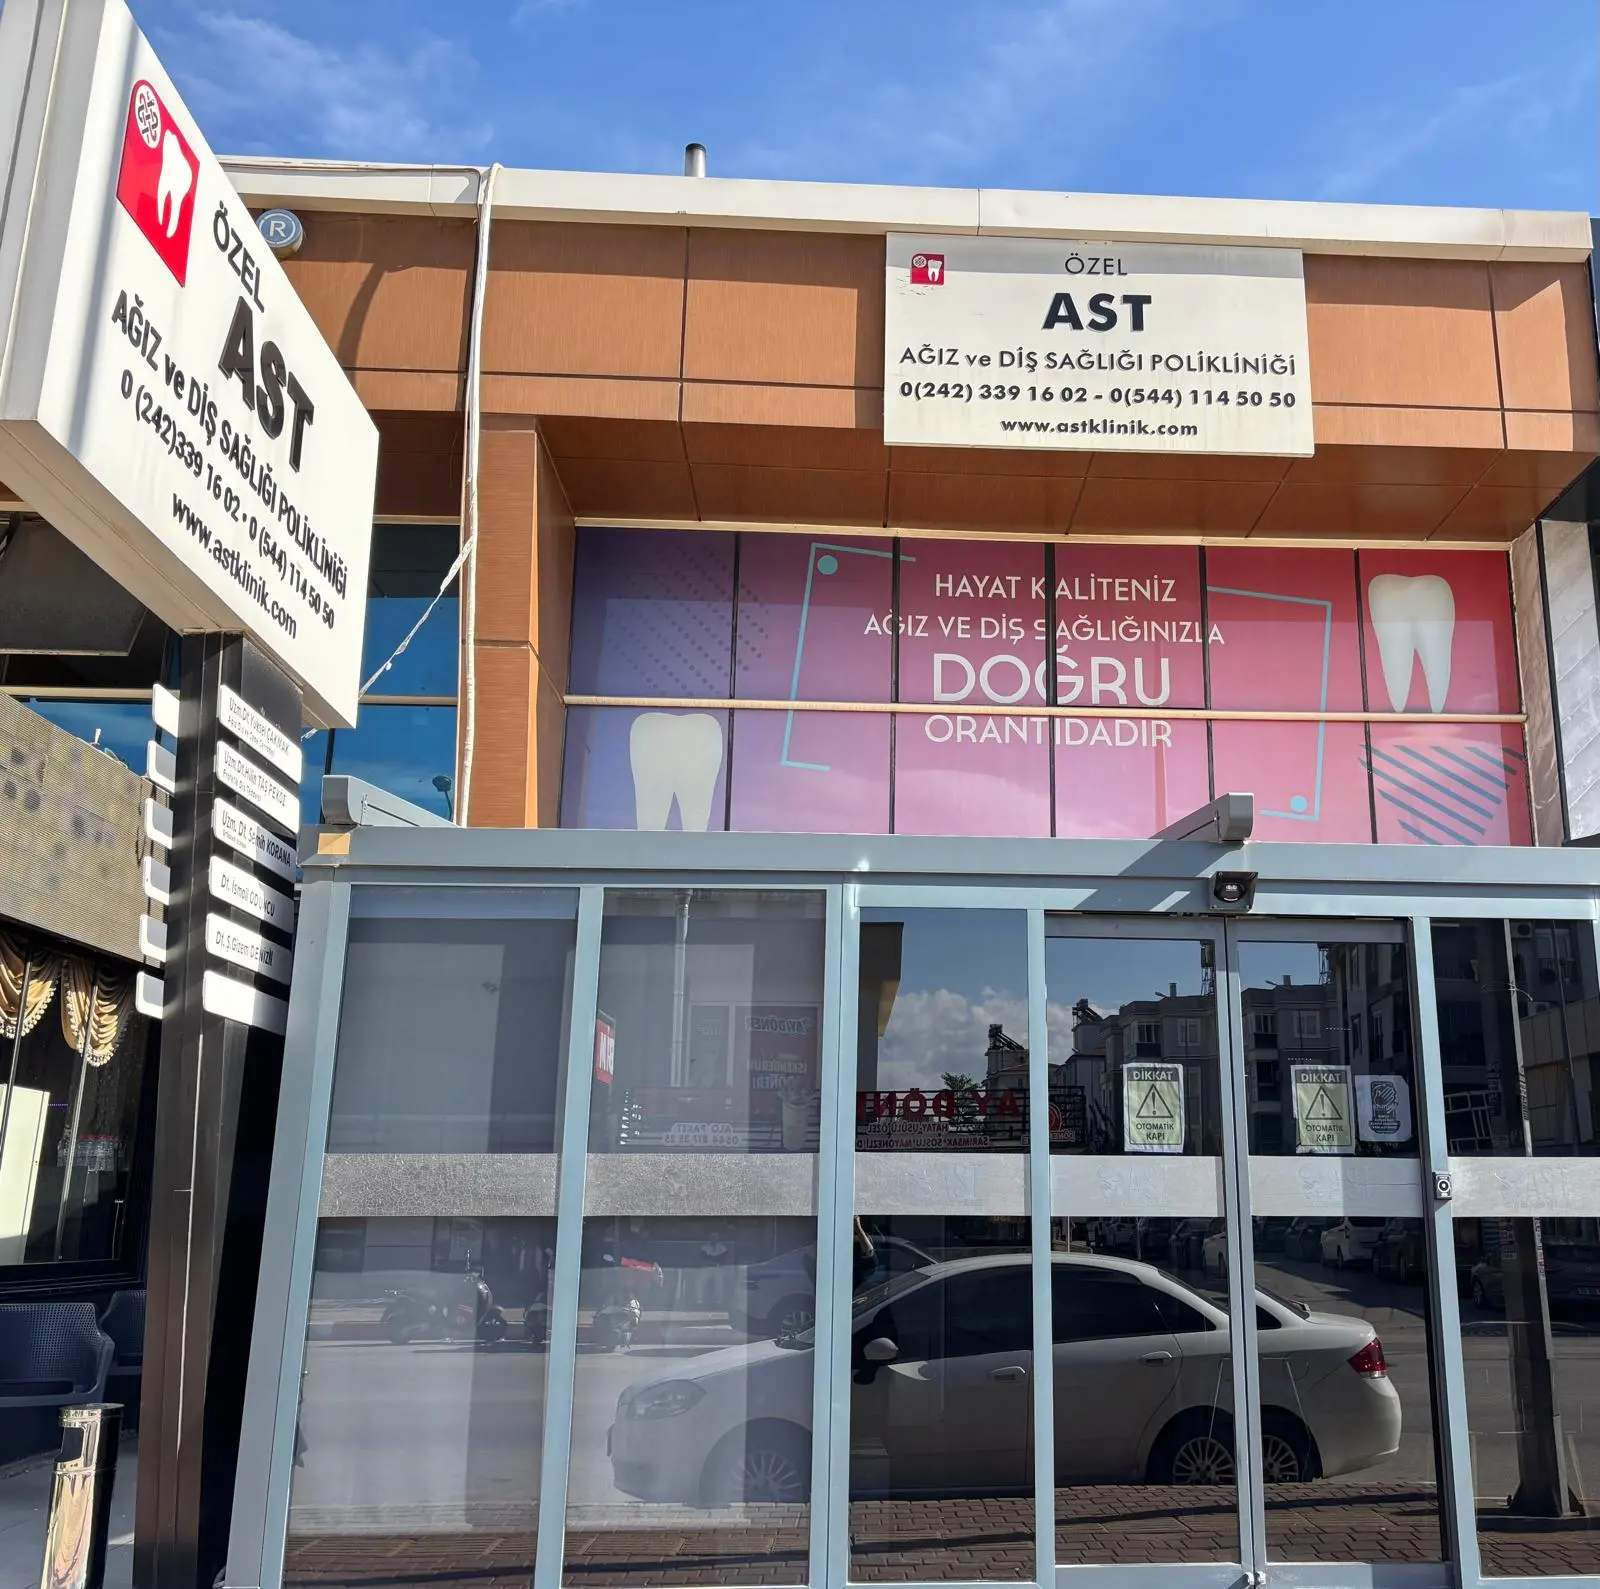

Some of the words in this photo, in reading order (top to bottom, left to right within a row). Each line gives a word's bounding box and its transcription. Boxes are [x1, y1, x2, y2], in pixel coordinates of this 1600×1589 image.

[269, 220, 286, 238] R
[213, 200, 264, 313] ÖZEL
[1064, 253, 1128, 276] ÖZEL
[1041, 292, 1152, 332] AST
[900, 344, 959, 366] AĞIZ
[965, 353, 991, 367] ve
[999, 346, 1038, 373] DİŞ
[1045, 349, 1143, 371] SAĞLIĞI
[1151, 350, 1296, 376] POLİKLİNİĞİ
[218, 296, 314, 473] AST
[900, 381, 973, 403] 0(242)
[979, 384, 1020, 401] 339
[1029, 385, 1054, 402] 16
[1061, 387, 1087, 403] 02
[1110, 387, 1182, 409] 0(544)
[1190, 389, 1230, 407] 114
[1236, 391, 1262, 407] 50
[1270, 391, 1296, 408] 50
[1000, 418, 1198, 436] www.astklinik.com
[111, 290, 162, 371] AĞIZ
[165, 354, 185, 399] ve
[188, 377, 217, 446] DİŞ
[220, 419, 277, 513] SAĞLIĞI
[278, 492, 348, 600] POLİKLİNİĞİ
[207, 464, 222, 500] 16
[224, 490, 239, 522] 02
[249, 516, 257, 541] 0
[259, 526, 287, 581] (544)
[290, 561, 308, 600] 114
[308, 586, 321, 615] 50
[322, 602, 335, 630] 50
[172, 493, 297, 639] www.astklinik.com
[935, 573, 1021, 599] HAYAT
[1031, 573, 1177, 602] KALİTENİZ
[864, 608, 929, 638] AĞIZ
[938, 615, 971, 638] VE
[980, 613, 1025, 645] DİŞ
[1034, 614, 1225, 645] SAĞLIĞINIZLA
[933, 644, 1170, 706] DOĞRU
[924, 714, 1173, 748] ORANTIDADIR
[266, 840, 291, 867] KORANA
[1133, 1070, 1173, 1081] DİKKAT
[1301, 1071, 1341, 1083] DİKKAT
[1136, 1122, 1174, 1131] OTOMATİK
[1146, 1132, 1165, 1142] KAPI
[1305, 1124, 1344, 1133] OTOMATİK
[1316, 1133, 1335, 1143] KAPI
